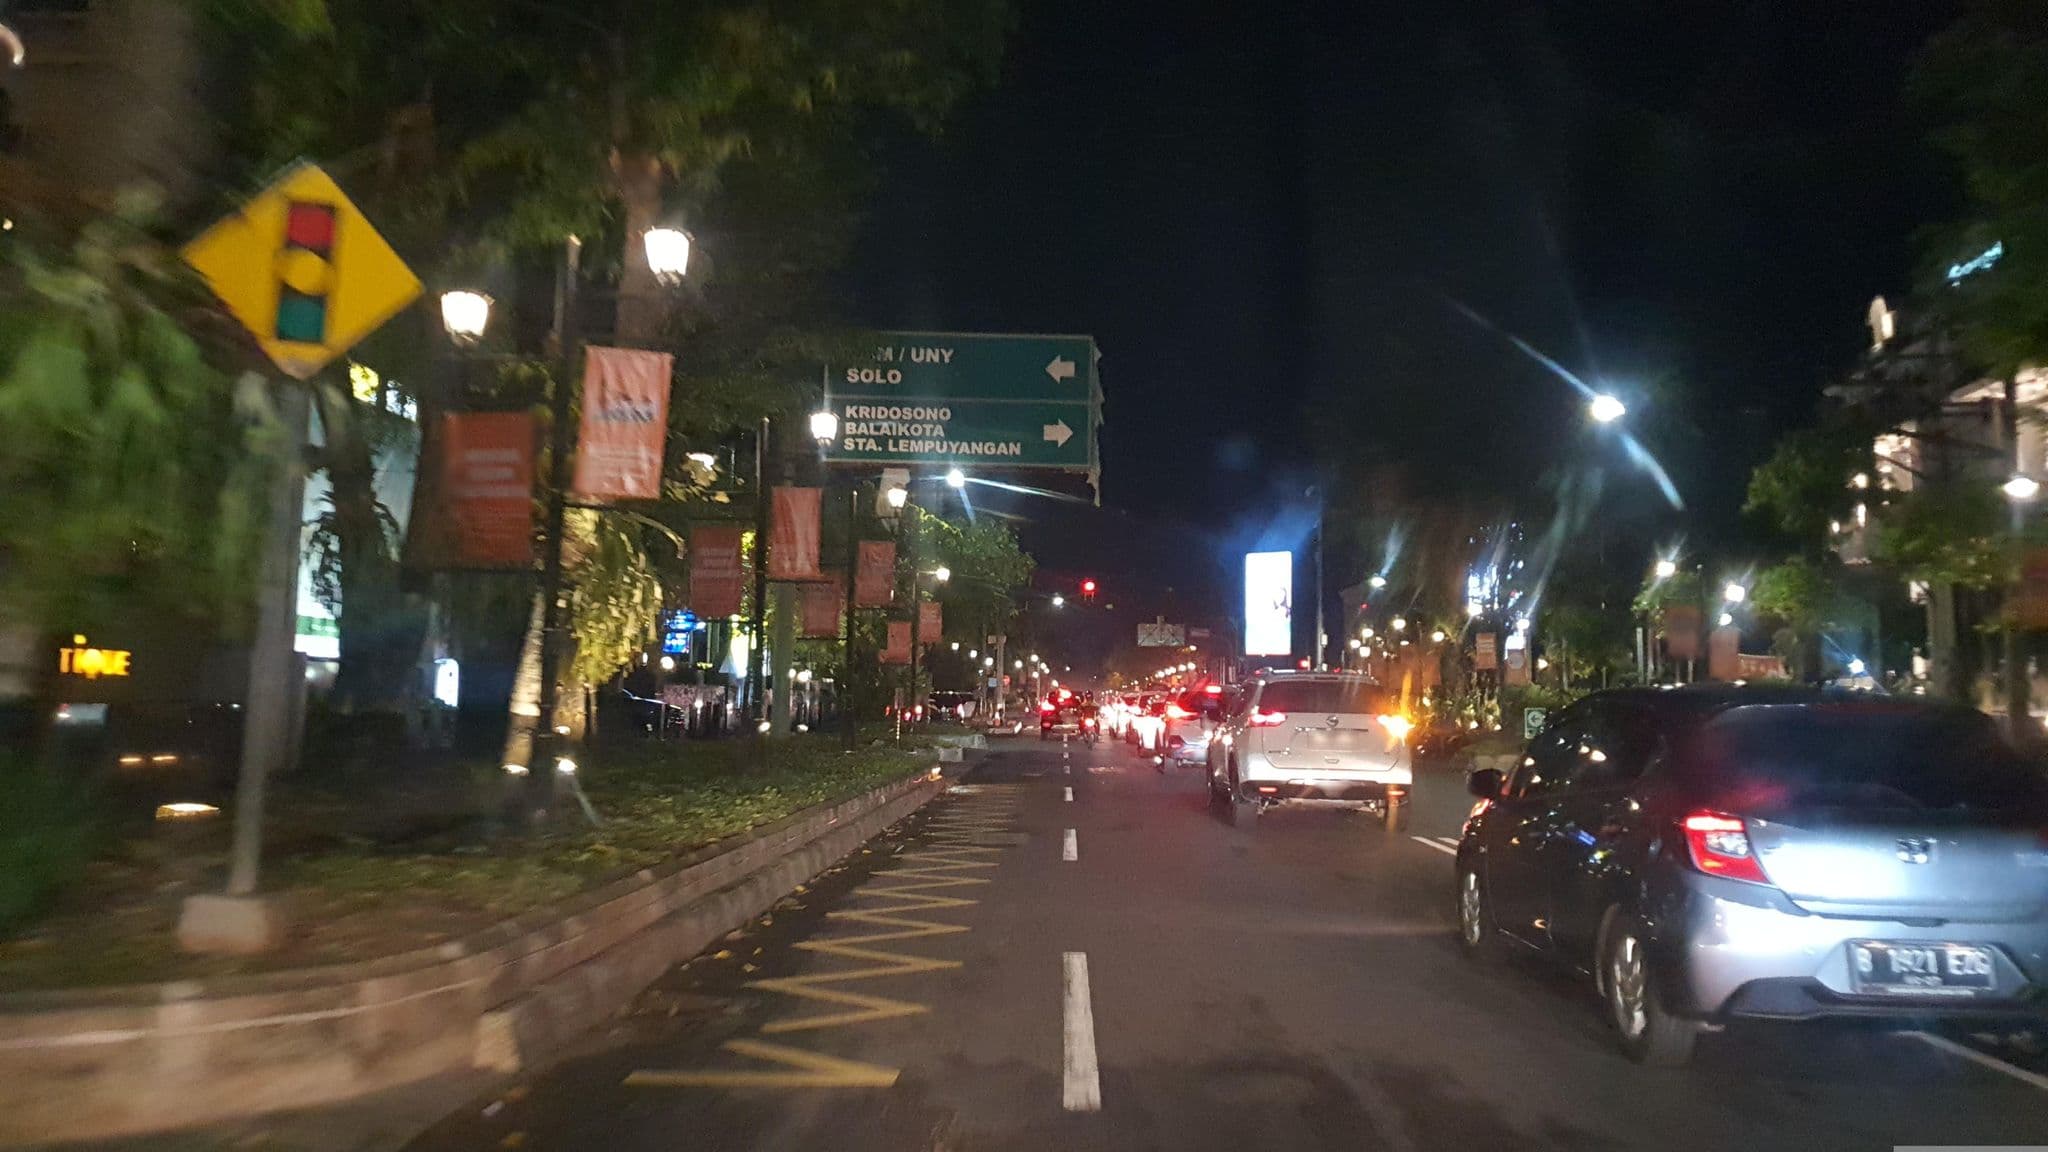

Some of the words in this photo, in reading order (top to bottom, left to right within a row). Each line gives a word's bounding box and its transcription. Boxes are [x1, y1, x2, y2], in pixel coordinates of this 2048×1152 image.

[911, 347, 954, 363] UNY
[846, 368, 902, 385] SOLO
[845, 405, 952, 421] KRIDOSONO
[844, 421, 946, 438] BALAIKOTA
[843, 437, 883, 452] STA.
[888, 439, 1022, 456] LEMPUYANGAN
